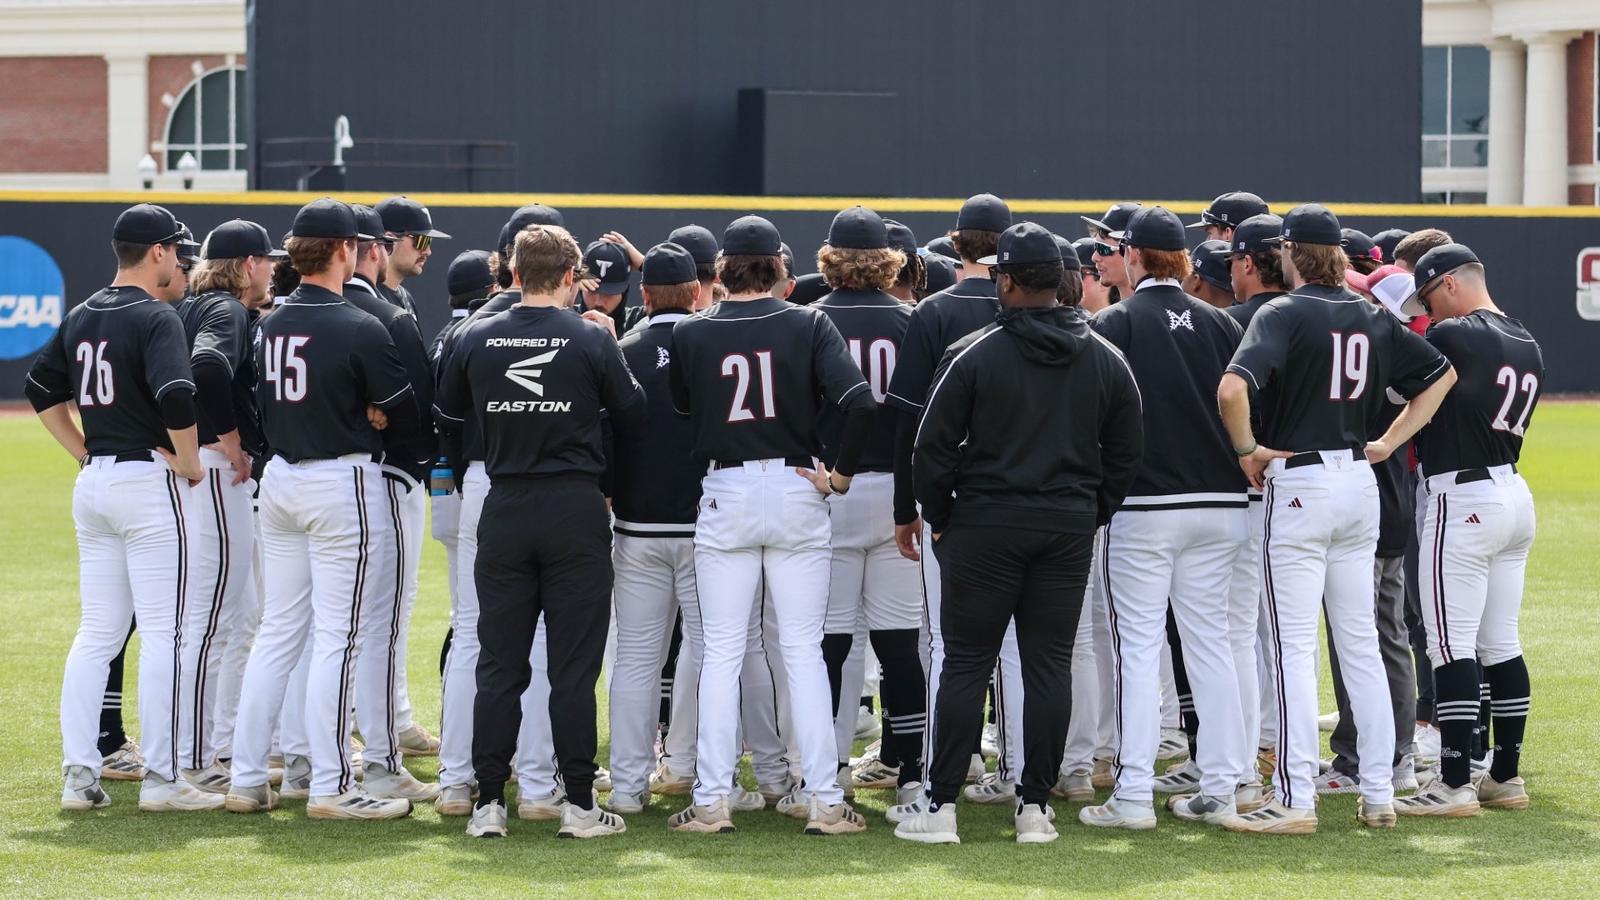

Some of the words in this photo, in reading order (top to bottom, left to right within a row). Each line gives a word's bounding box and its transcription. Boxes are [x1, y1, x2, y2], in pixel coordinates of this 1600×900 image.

[595, 259, 614, 278] T
[0, 294, 62, 329] CAA
[485, 338, 548, 348] POWERED
[550, 338, 570, 348] BY
[76, 341, 115, 407] 26
[264, 335, 312, 402] 45
[720, 350, 778, 423] 21
[1329, 332, 1370, 400] 19
[486, 401, 572, 413] EASTON
[1491, 366, 1539, 438] 22
